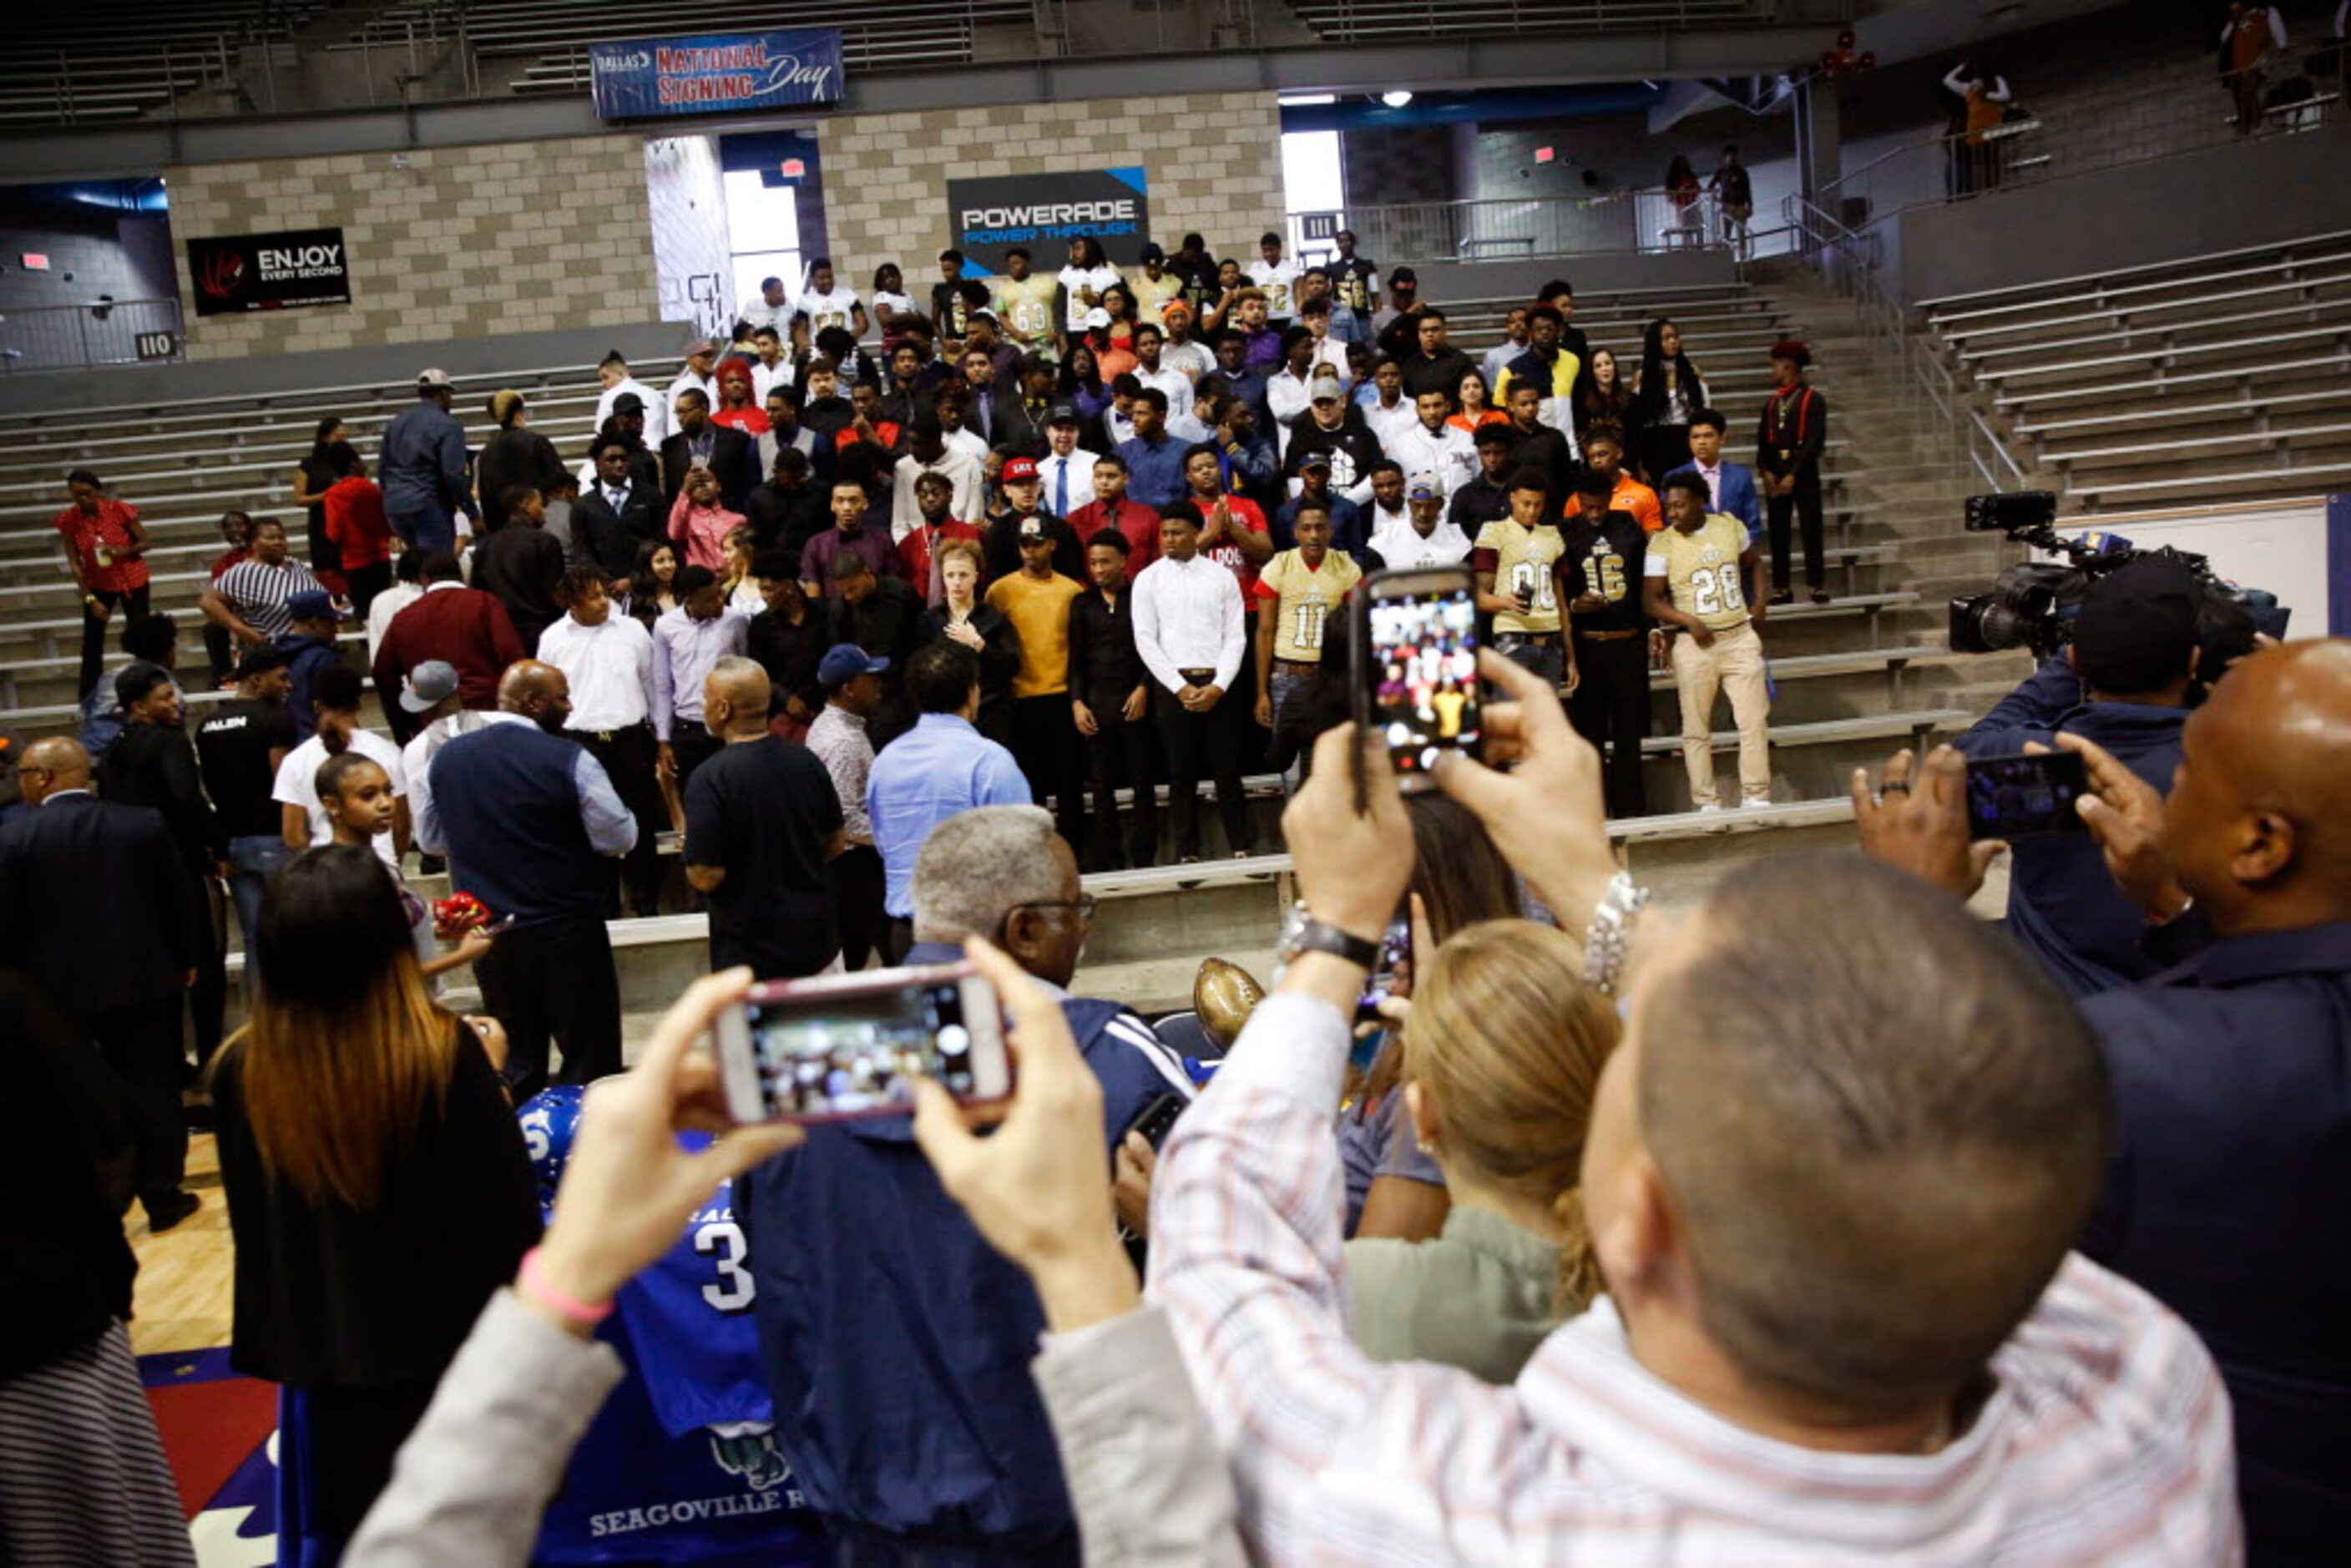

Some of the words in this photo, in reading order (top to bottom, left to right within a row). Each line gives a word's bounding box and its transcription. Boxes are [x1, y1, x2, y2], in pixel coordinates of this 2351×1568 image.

[655, 44, 770, 73] NATIONAL
[658, 73, 754, 104] SIGNING
[752, 53, 832, 102] Day
[962, 200, 1135, 230] POWERADE
[963, 227, 1038, 245] POWER
[1043, 220, 1136, 240] THROUGH
[257, 245, 340, 270] ENJOY
[260, 271, 296, 281] EVERY
[297, 265, 343, 279] SECOND
[1016, 302, 1045, 332] 63
[140, 334, 170, 357] 110
[1581, 556, 1627, 600] 16
[1691, 562, 1742, 615] 28
[1293, 604, 1327, 649] 11
[201, 716, 247, 733] JALEN
[694, 1222, 756, 1312] 3
[589, 1490, 781, 1537] SEAGOVILLE
